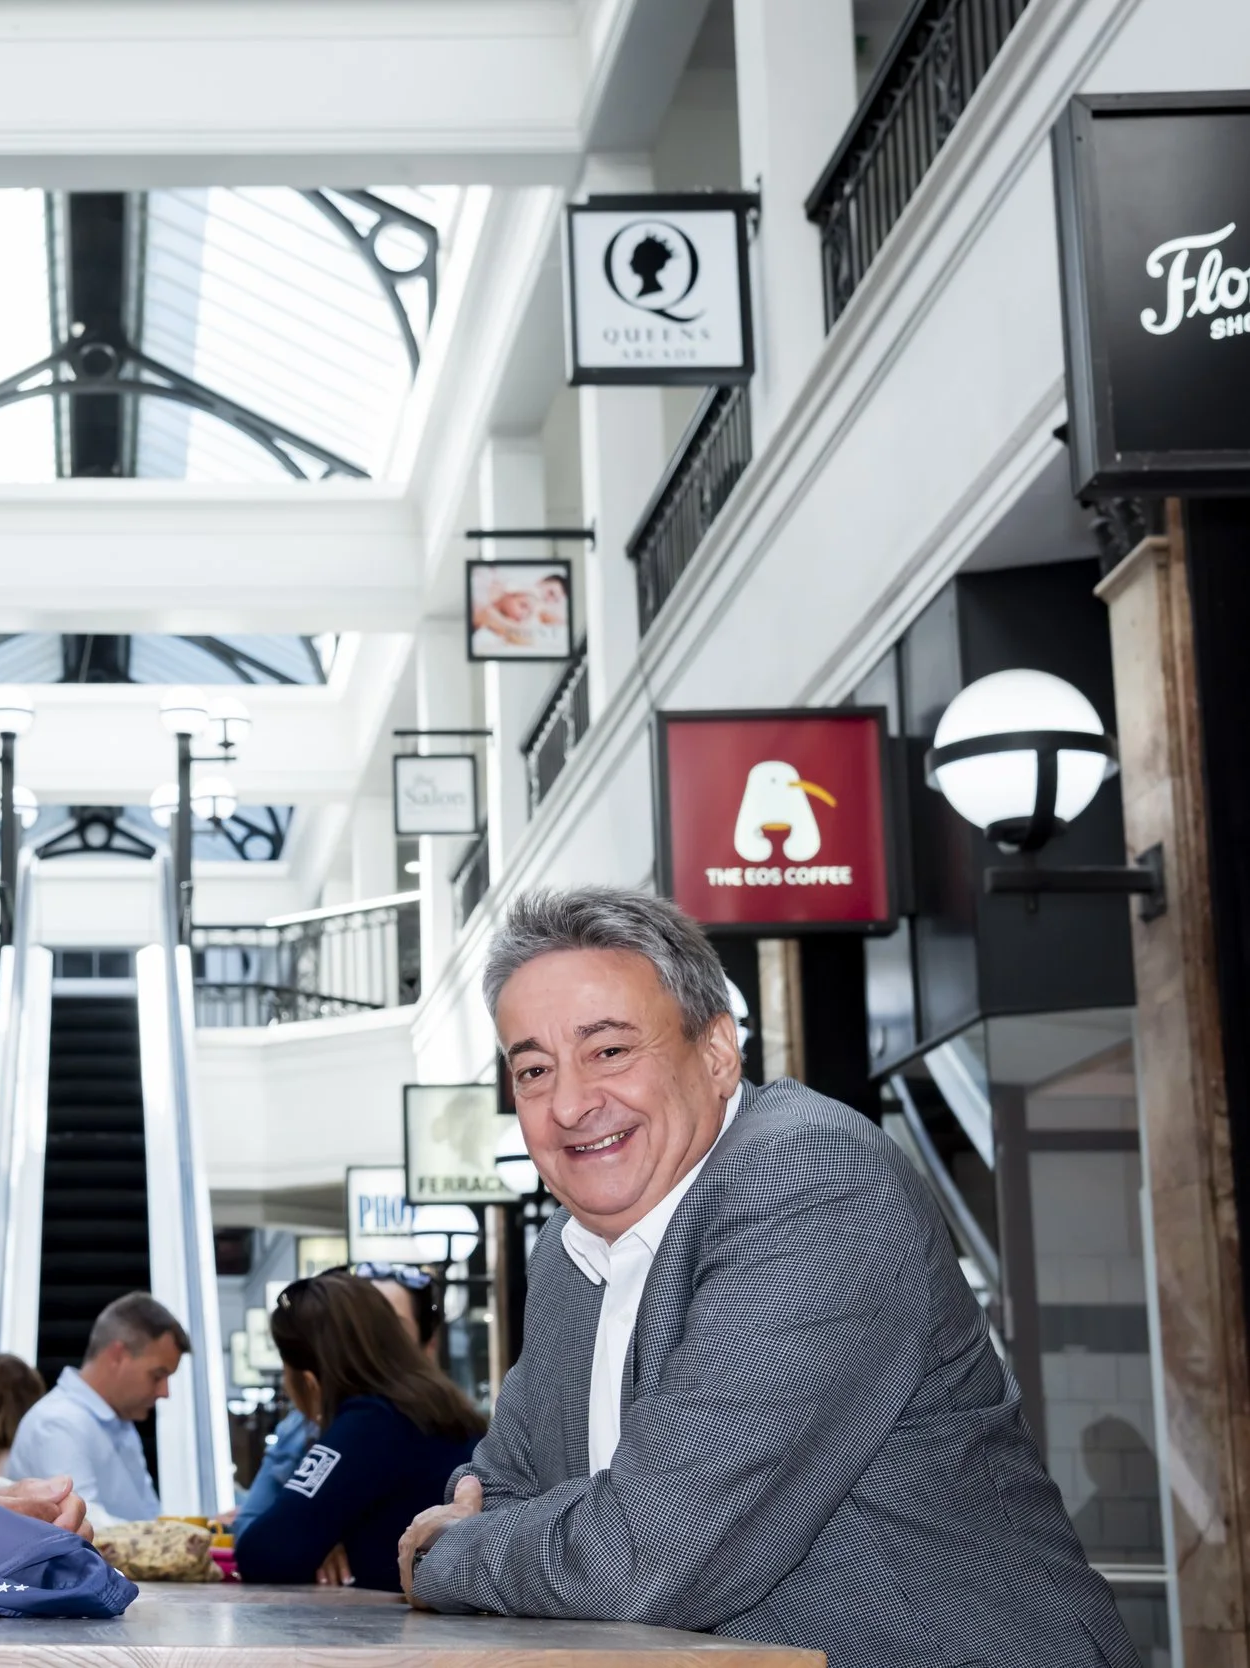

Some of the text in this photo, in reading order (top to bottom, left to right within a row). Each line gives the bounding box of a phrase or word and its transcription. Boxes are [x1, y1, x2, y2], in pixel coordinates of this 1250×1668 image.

[1140, 222, 1250, 335] Flo
[603, 327, 711, 345] QUEENS
[705, 866, 853, 886] THE EOS COFFEE
